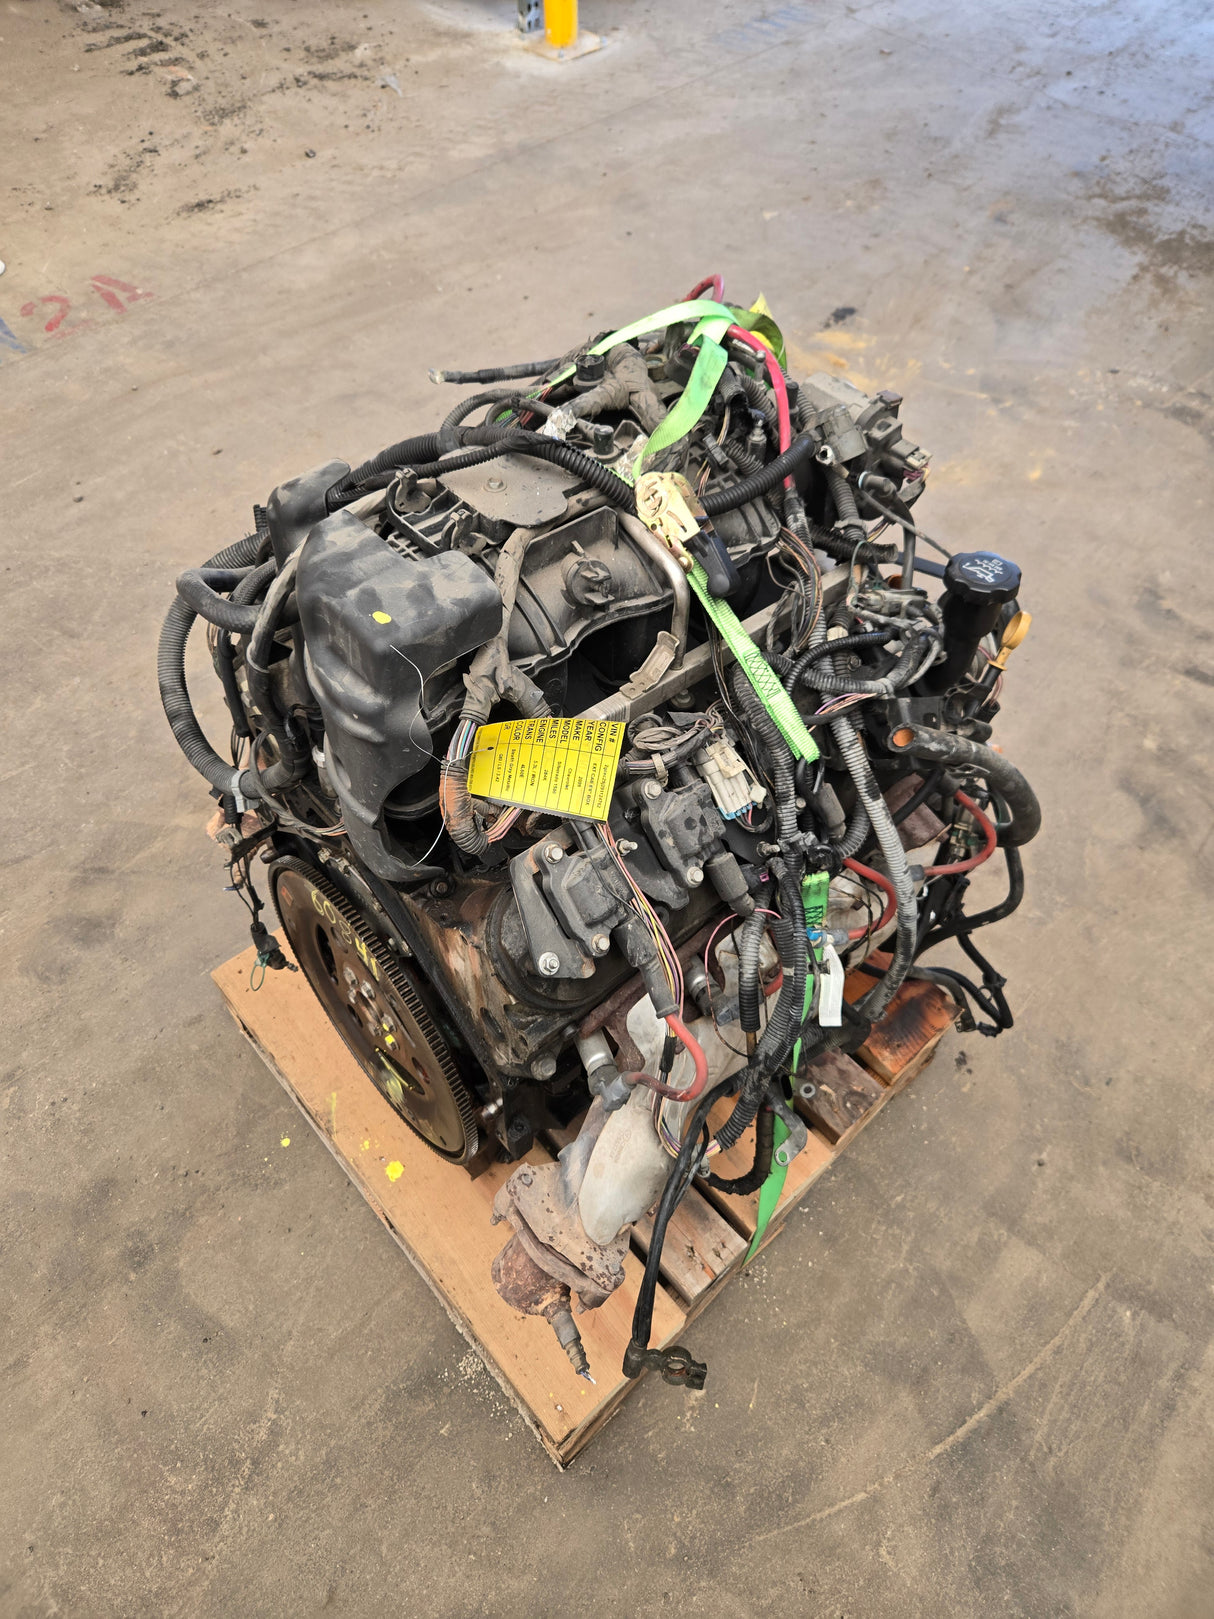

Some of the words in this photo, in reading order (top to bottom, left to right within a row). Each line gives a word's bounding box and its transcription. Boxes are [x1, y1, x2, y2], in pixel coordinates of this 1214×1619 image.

[513, 721, 524, 741] COLOR
[525, 720, 536, 740] TRANS
[536, 720, 547, 743] ENGINE
[549, 720, 559, 739] MILES
[560, 720, 571, 744] MODEL
[573, 720, 583, 741] MAKE
[585, 721, 595, 741] YEAR
[595, 722, 606, 752] CONFIG
[610, 723, 618, 736] VIN
